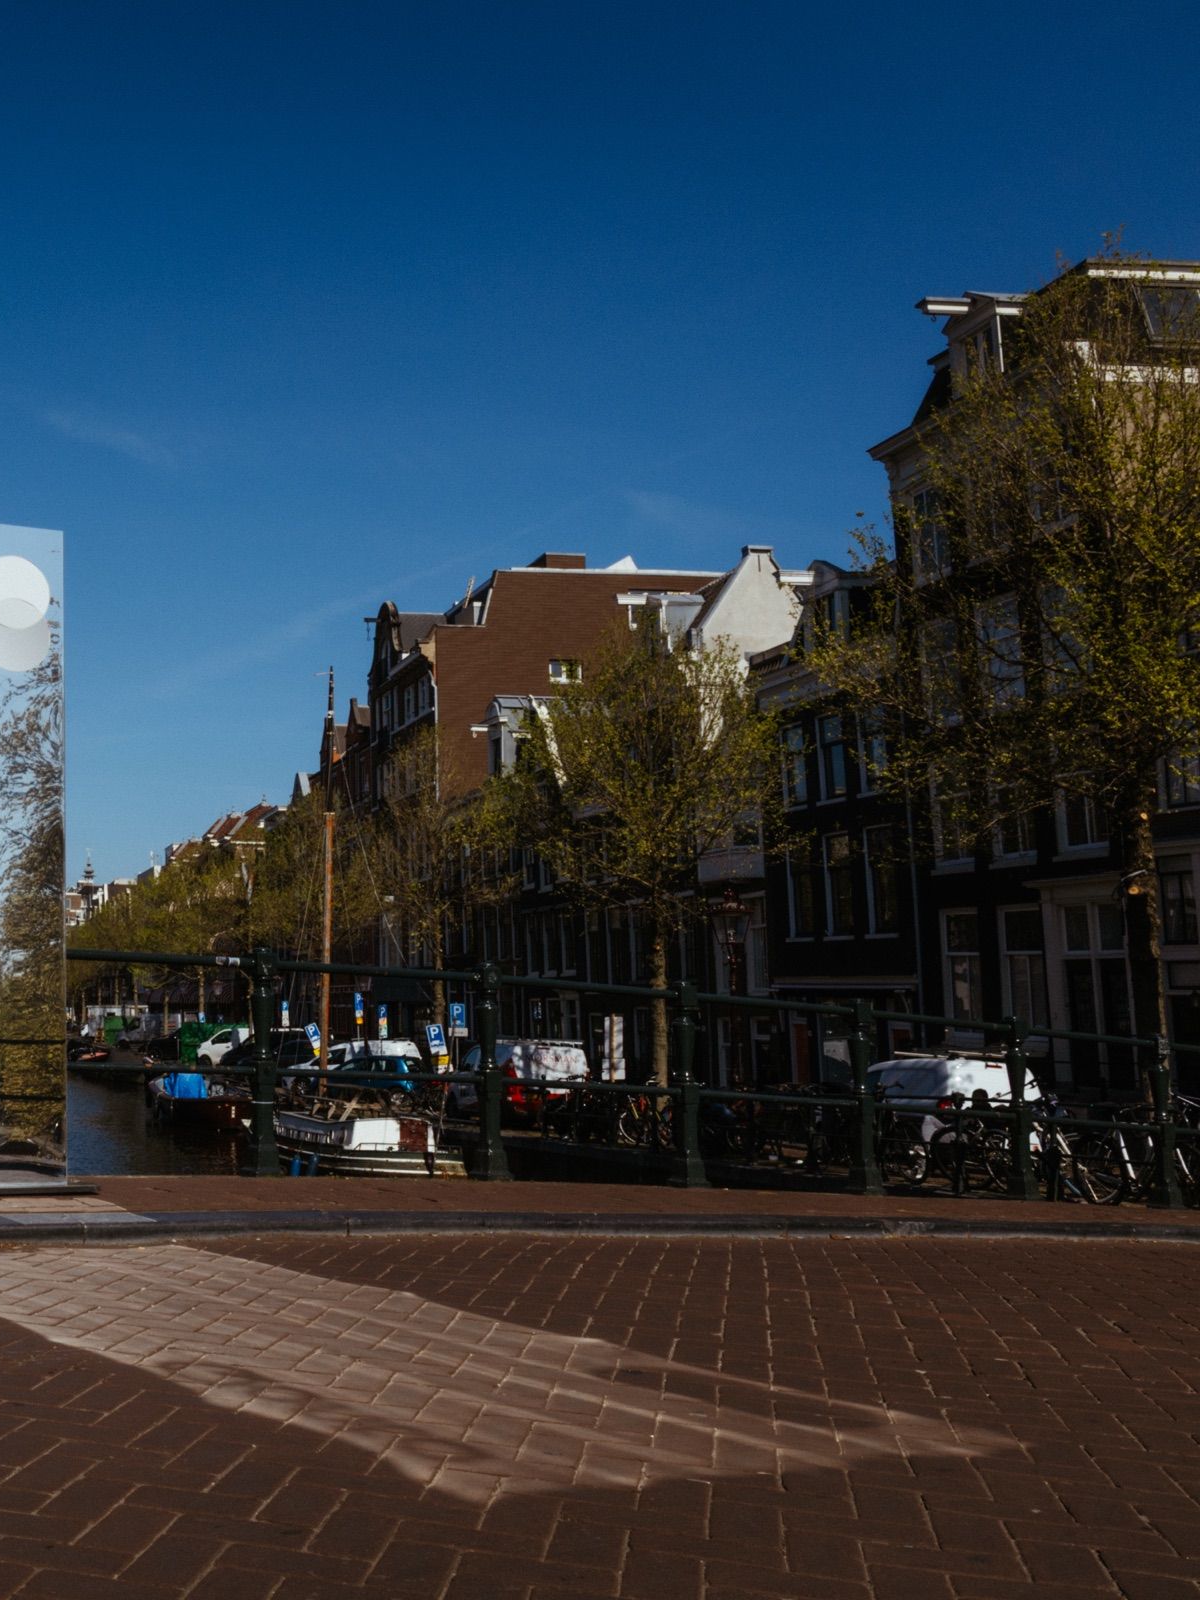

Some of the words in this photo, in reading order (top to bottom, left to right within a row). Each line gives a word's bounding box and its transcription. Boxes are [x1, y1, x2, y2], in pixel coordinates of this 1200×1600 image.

[453, 1005, 462, 1016] P
[308, 1025, 316, 1036] P
[430, 1026, 440, 1039] P
